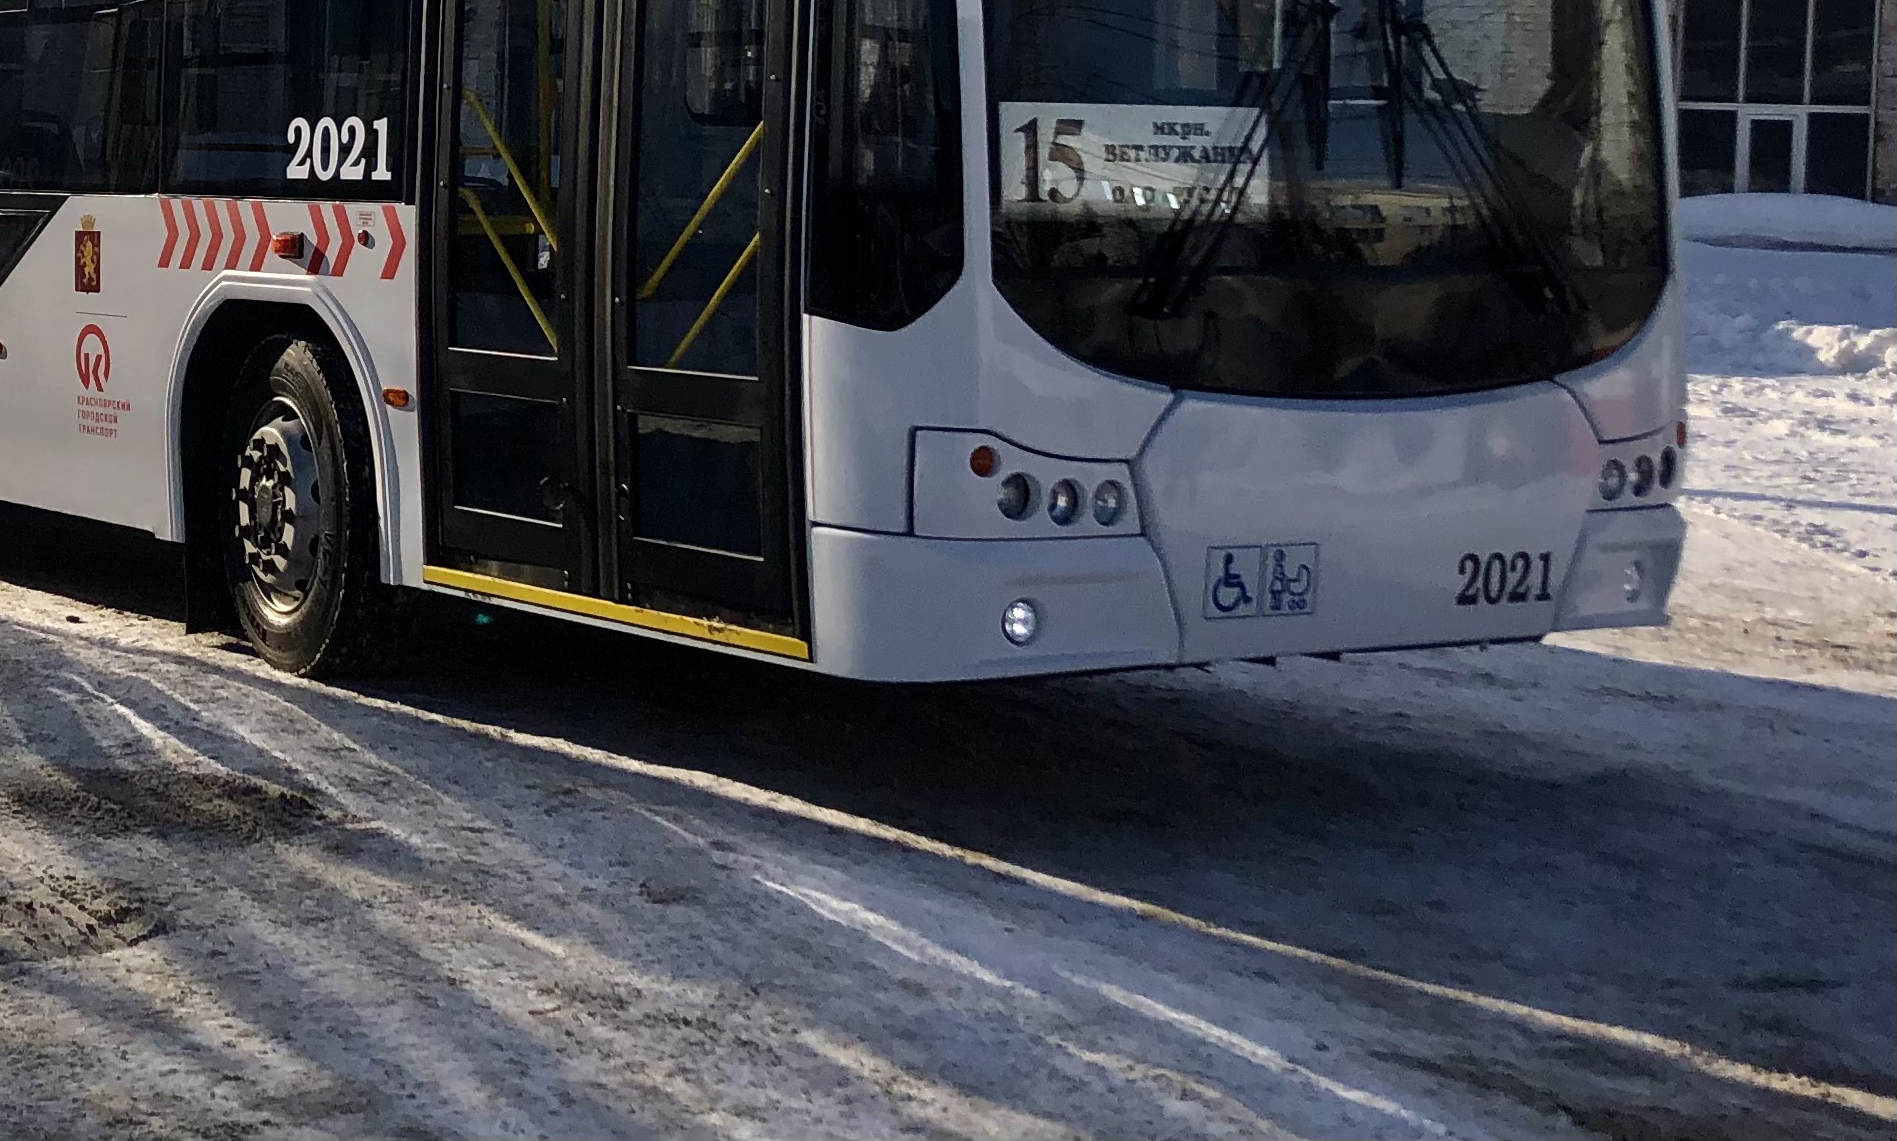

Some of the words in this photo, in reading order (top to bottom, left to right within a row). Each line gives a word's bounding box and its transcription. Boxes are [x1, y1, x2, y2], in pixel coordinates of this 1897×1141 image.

[287, 116, 392, 181] 2021
[1013, 116, 1086, 203] 15
[1152, 121, 1211, 140] мкрн.
[1454, 550, 1552, 606] 2021
